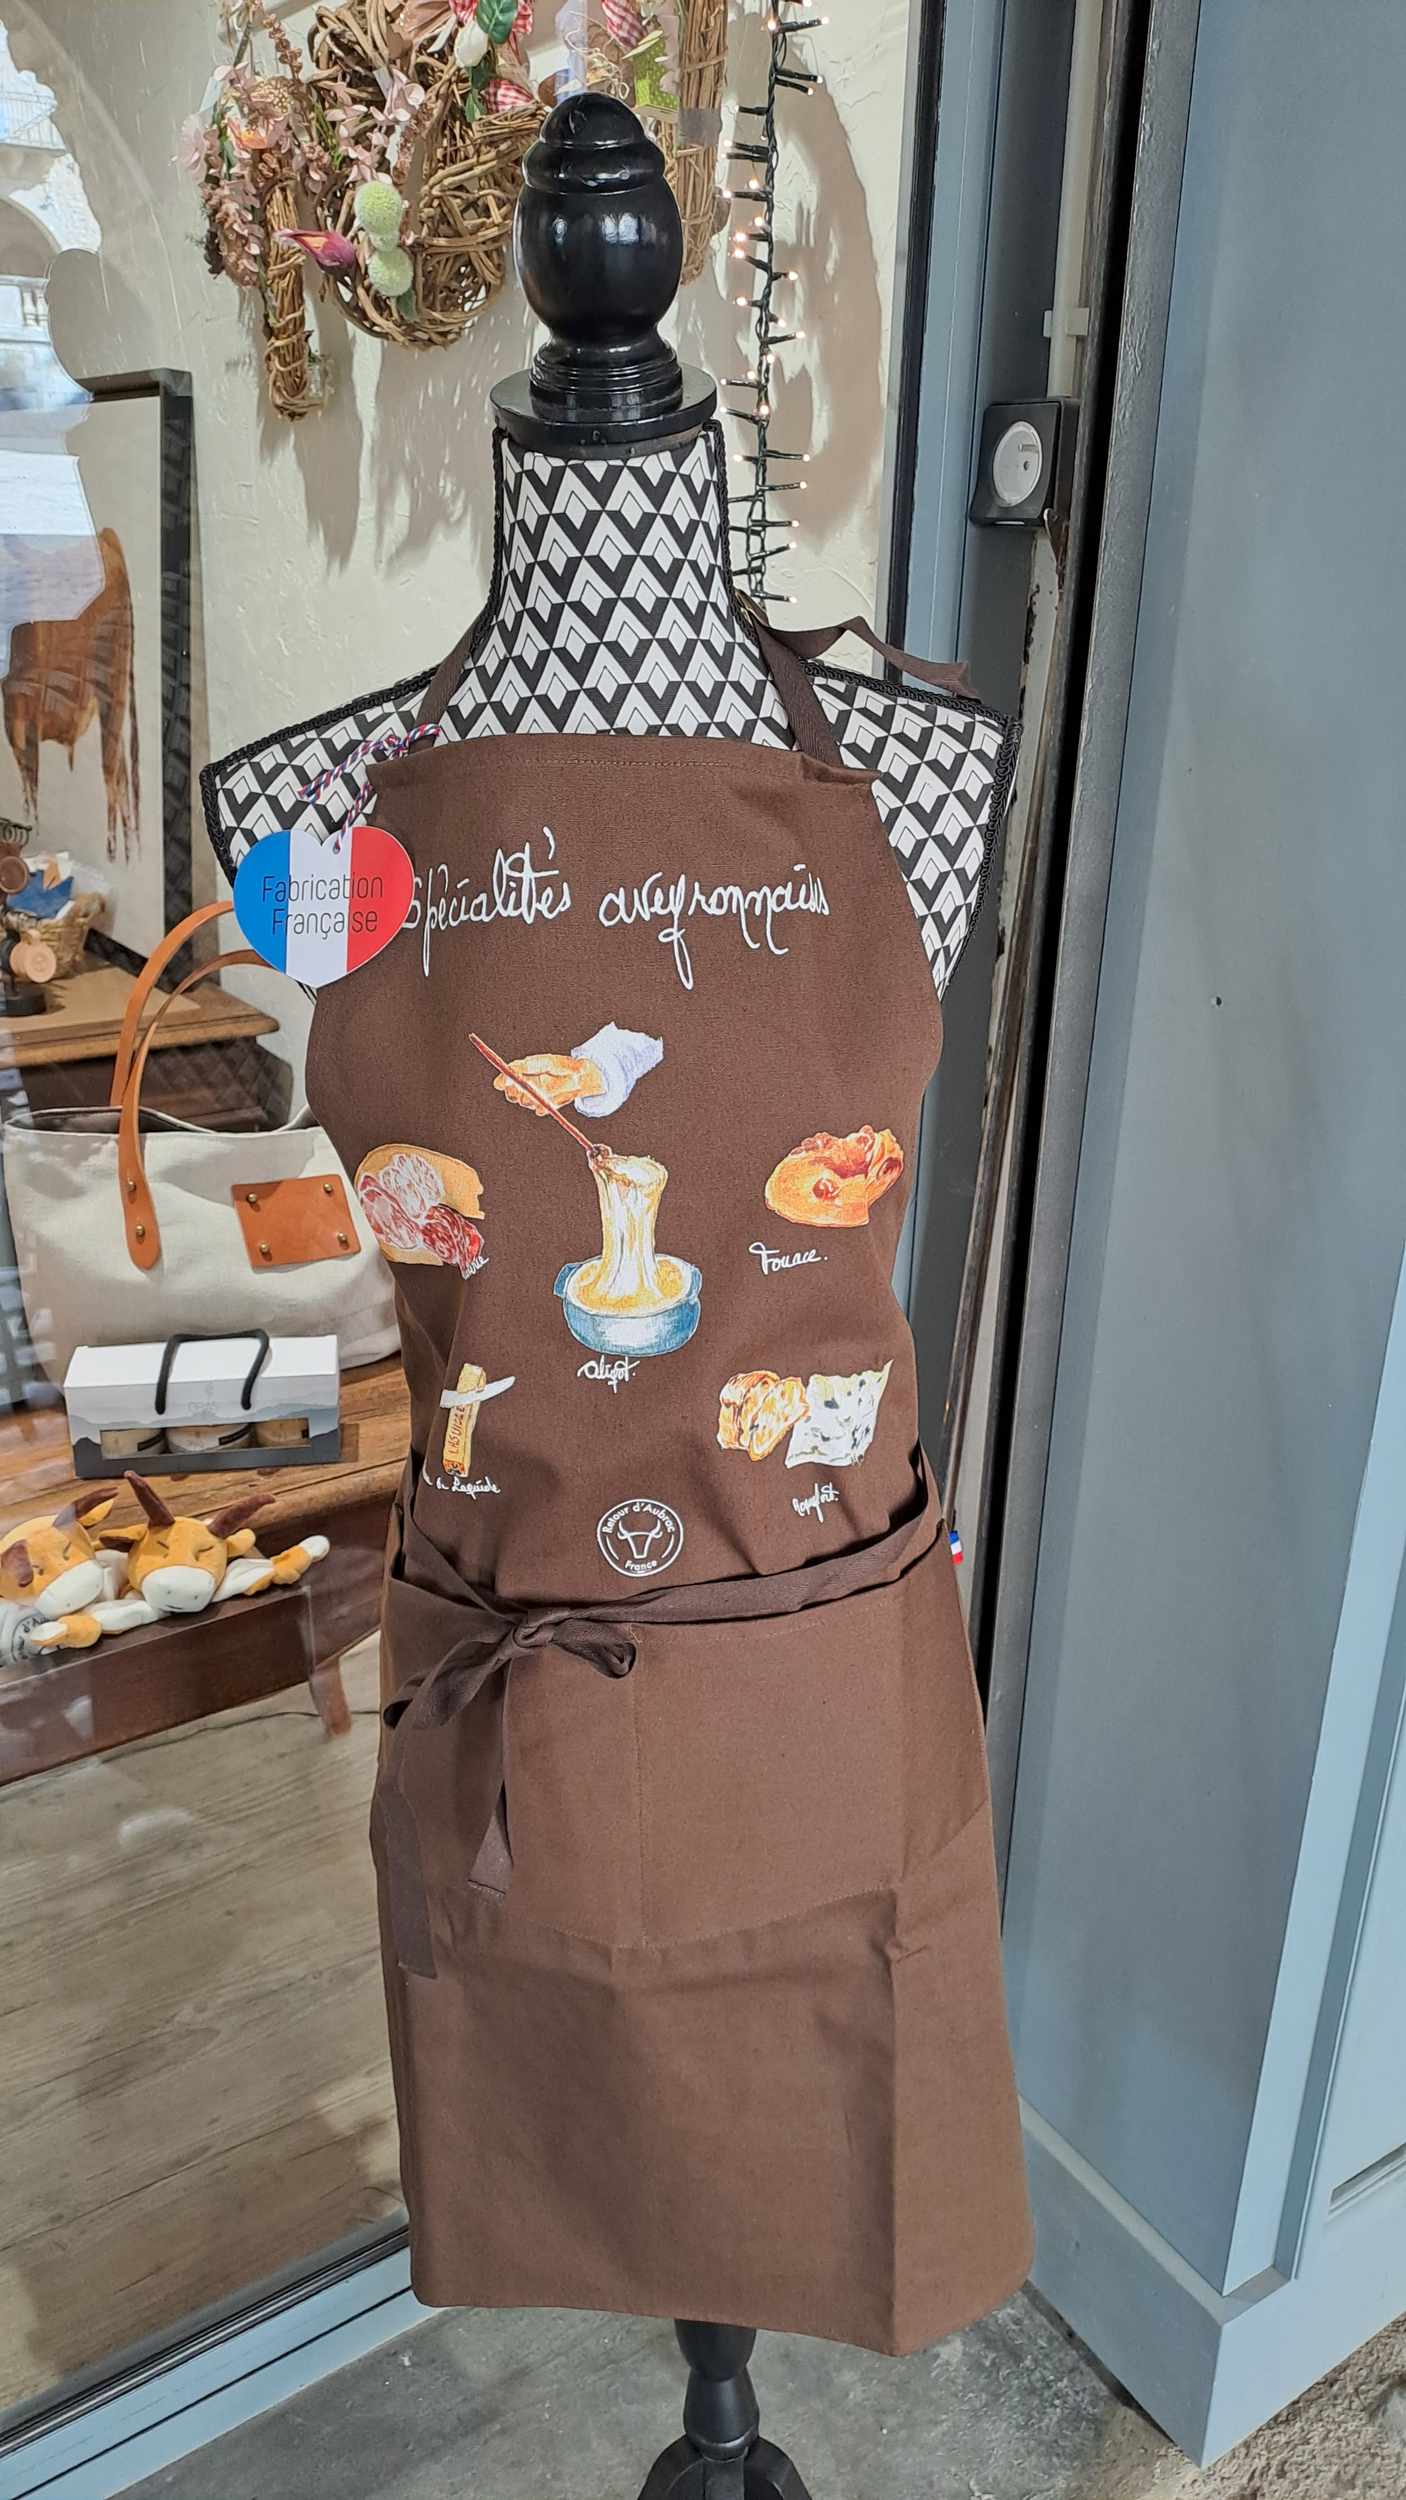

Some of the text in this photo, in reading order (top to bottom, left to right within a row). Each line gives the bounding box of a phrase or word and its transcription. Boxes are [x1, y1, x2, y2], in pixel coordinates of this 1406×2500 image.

[261, 873, 384, 903] Fabrication
[271, 906, 378, 940] Française
[601, 1501, 676, 1534] Retour d'Aubrac
[624, 1559, 658, 1571] France
